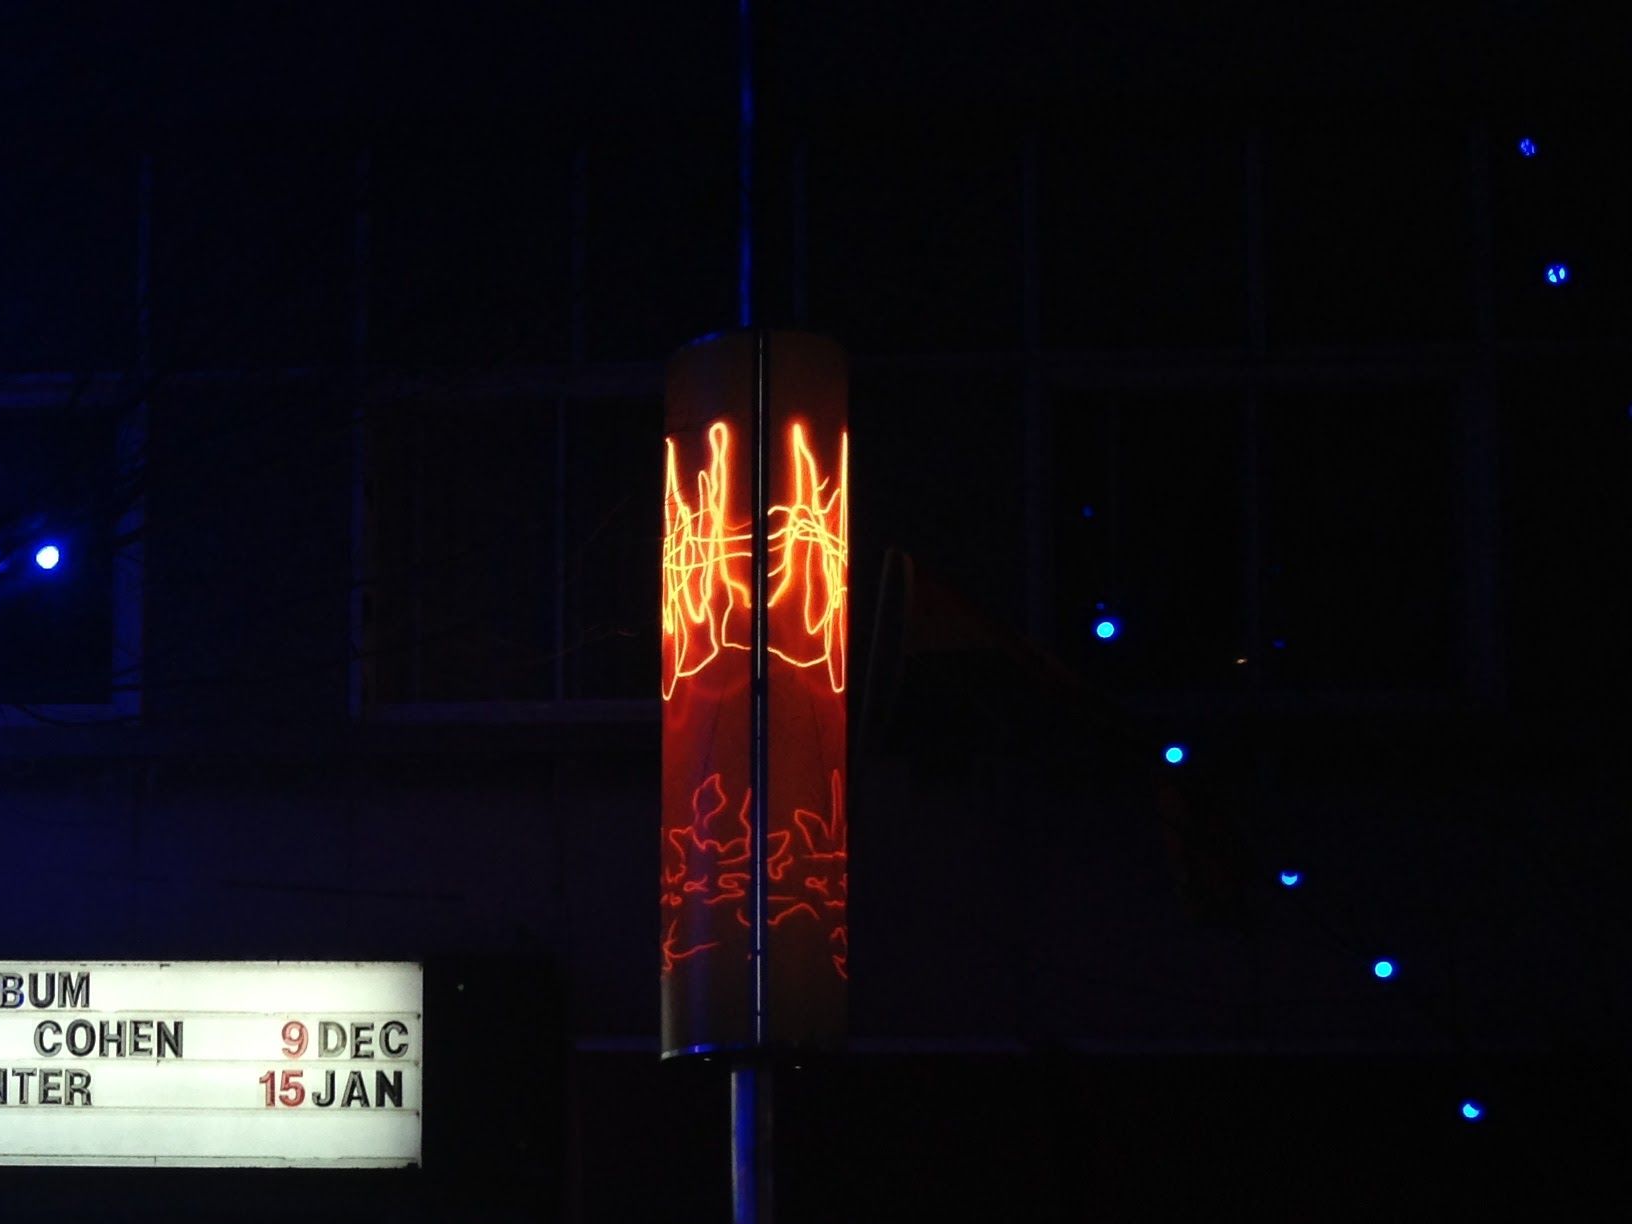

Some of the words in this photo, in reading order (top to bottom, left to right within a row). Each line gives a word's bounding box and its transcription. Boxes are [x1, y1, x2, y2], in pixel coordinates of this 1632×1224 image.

[33, 1019, 185, 1058] COHEN
[280, 1020, 310, 1060] 9
[317, 1020, 409, 1059] DEC
[258, 1069, 306, 1108] 15
[310, 1069, 404, 1109] JAN
